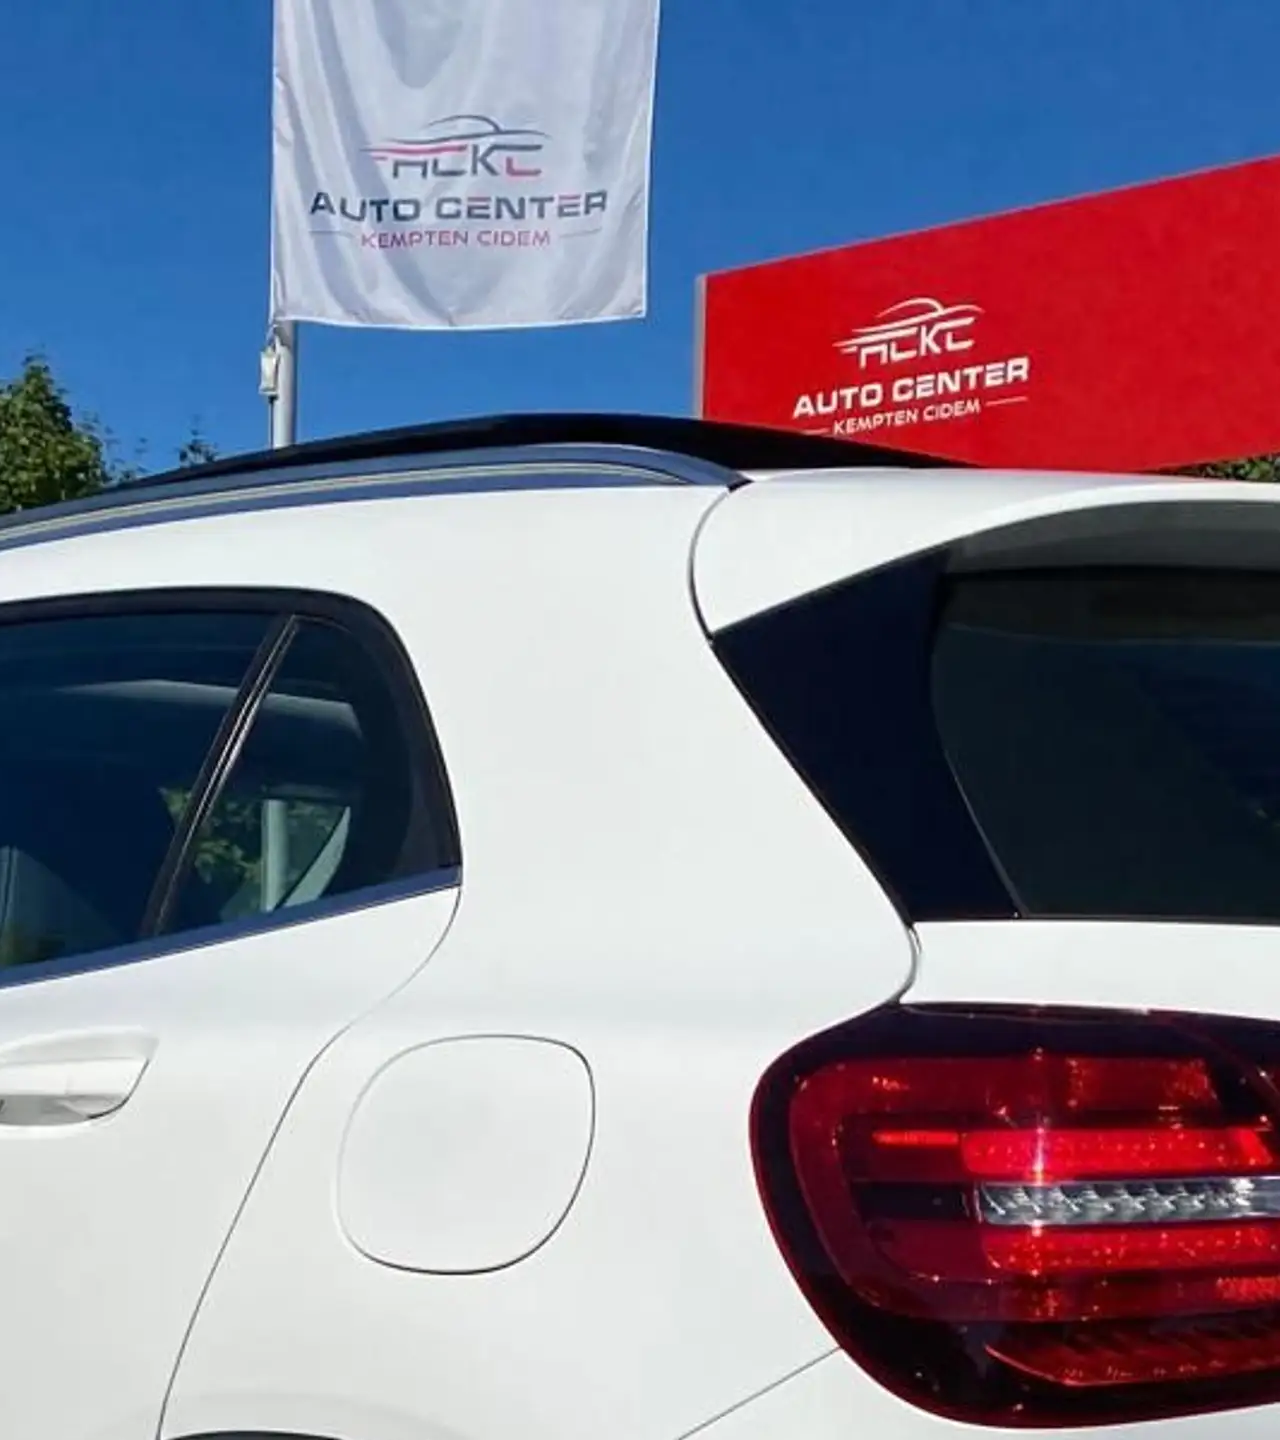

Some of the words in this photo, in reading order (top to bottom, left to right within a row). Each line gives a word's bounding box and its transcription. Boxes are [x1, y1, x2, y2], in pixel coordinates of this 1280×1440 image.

[309, 191, 421, 222] AUTO
[435, 189, 608, 220] CENTER
[361, 230, 469, 249] KEMPTEN
[478, 229, 551, 247] CIDEM
[793, 382, 883, 419] AUTO
[891, 356, 1030, 400] CENTER
[832, 408, 919, 436] KEMPTEN
[922, 398, 982, 423] CIDEM
